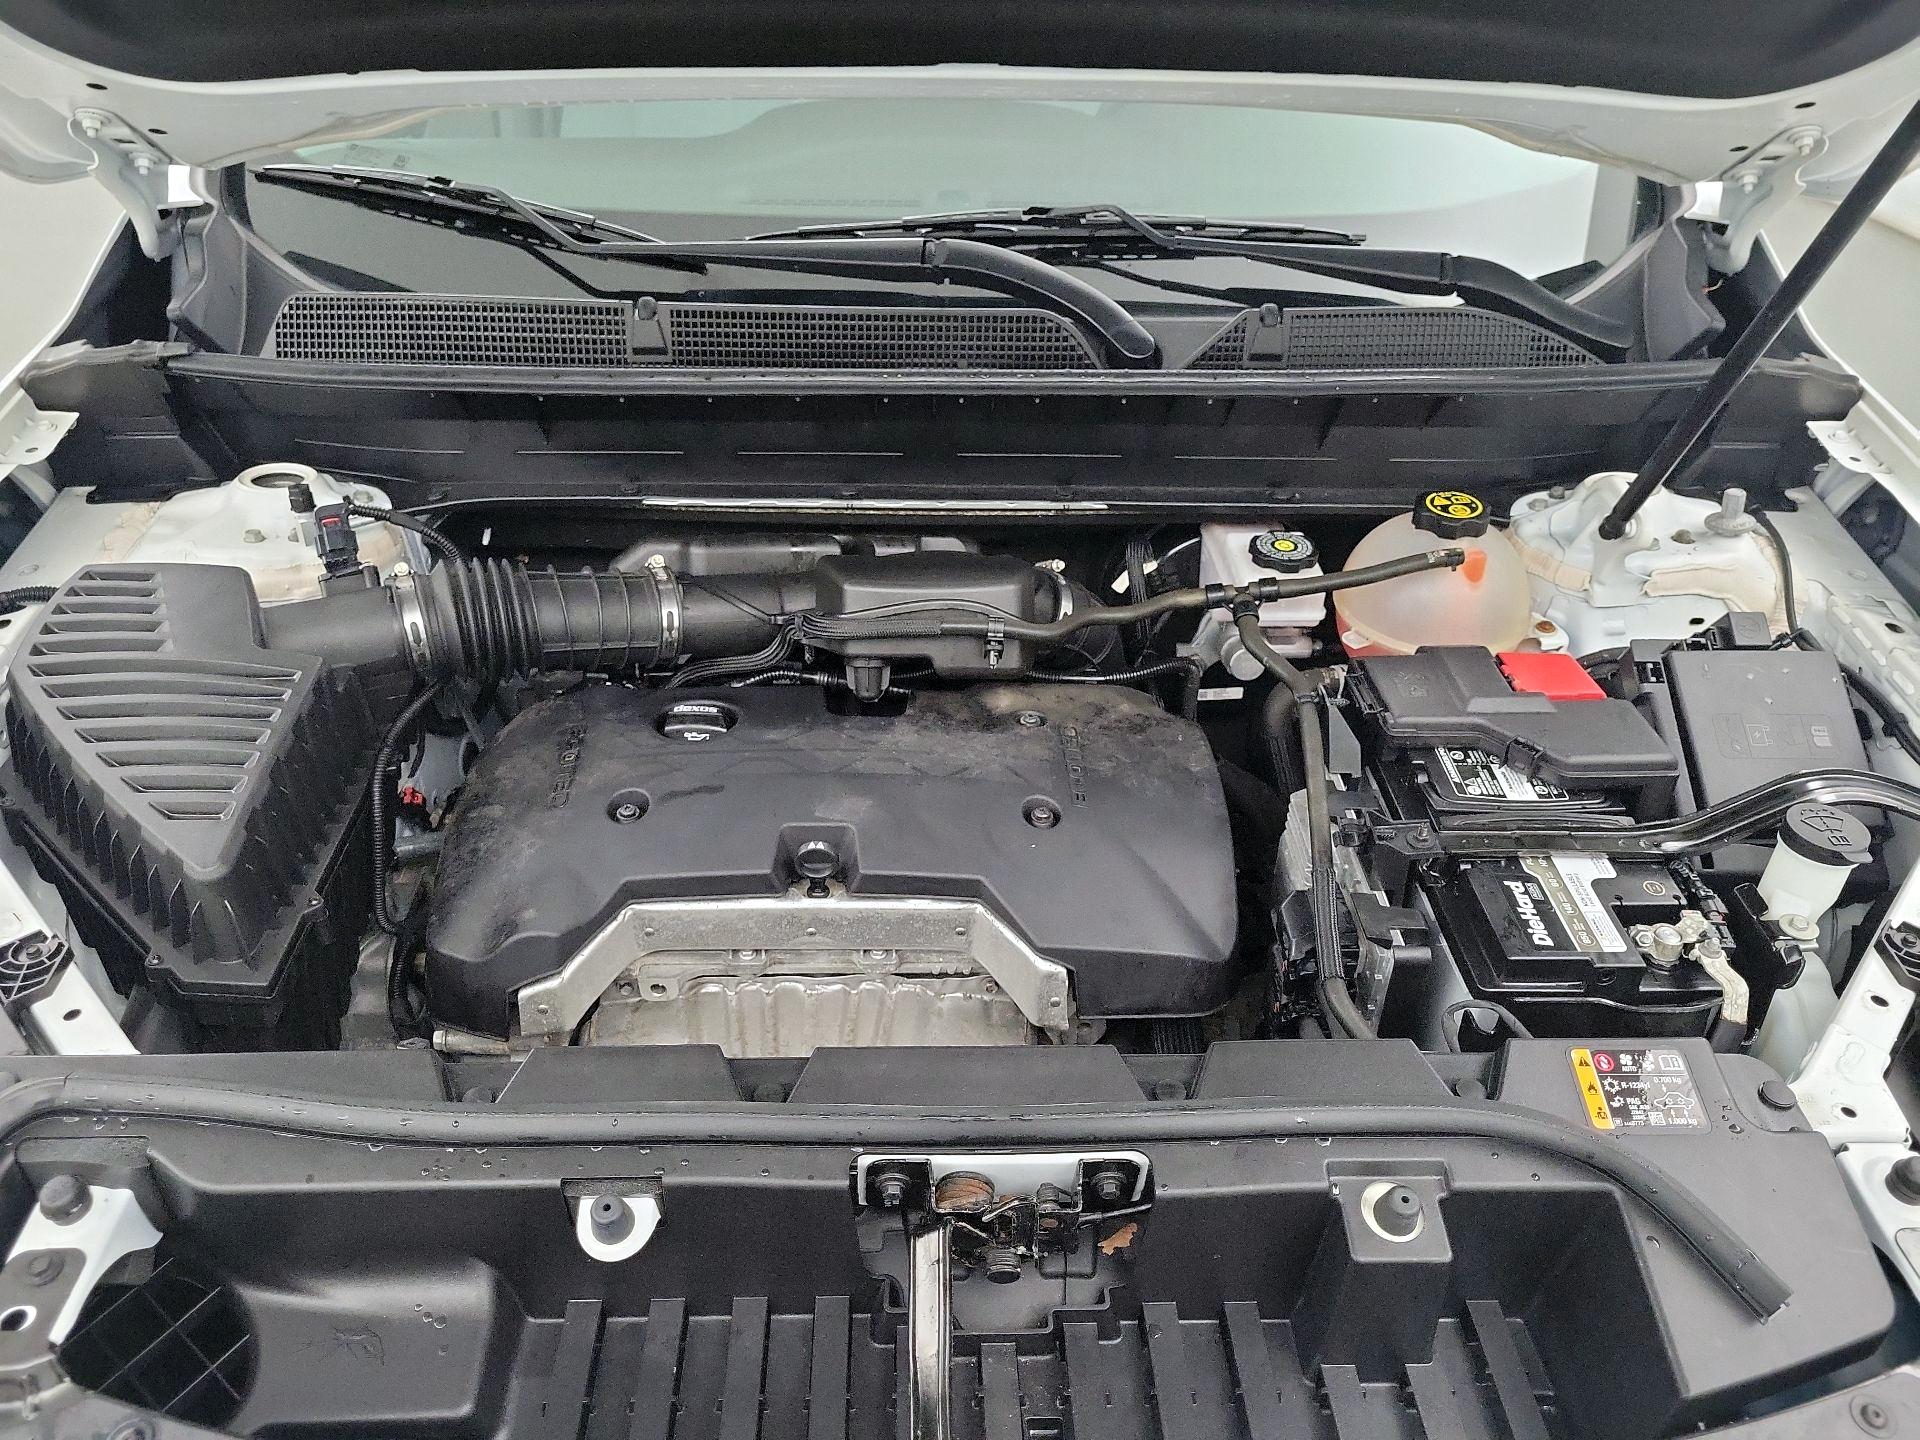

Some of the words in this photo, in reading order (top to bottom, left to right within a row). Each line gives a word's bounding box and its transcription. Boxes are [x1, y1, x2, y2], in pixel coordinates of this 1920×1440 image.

[674, 704, 719, 713] dexos
[1548, 878, 1560, 888] 80
[1503, 880, 1554, 946] DieHard
[1578, 931, 1592, 944] 850
